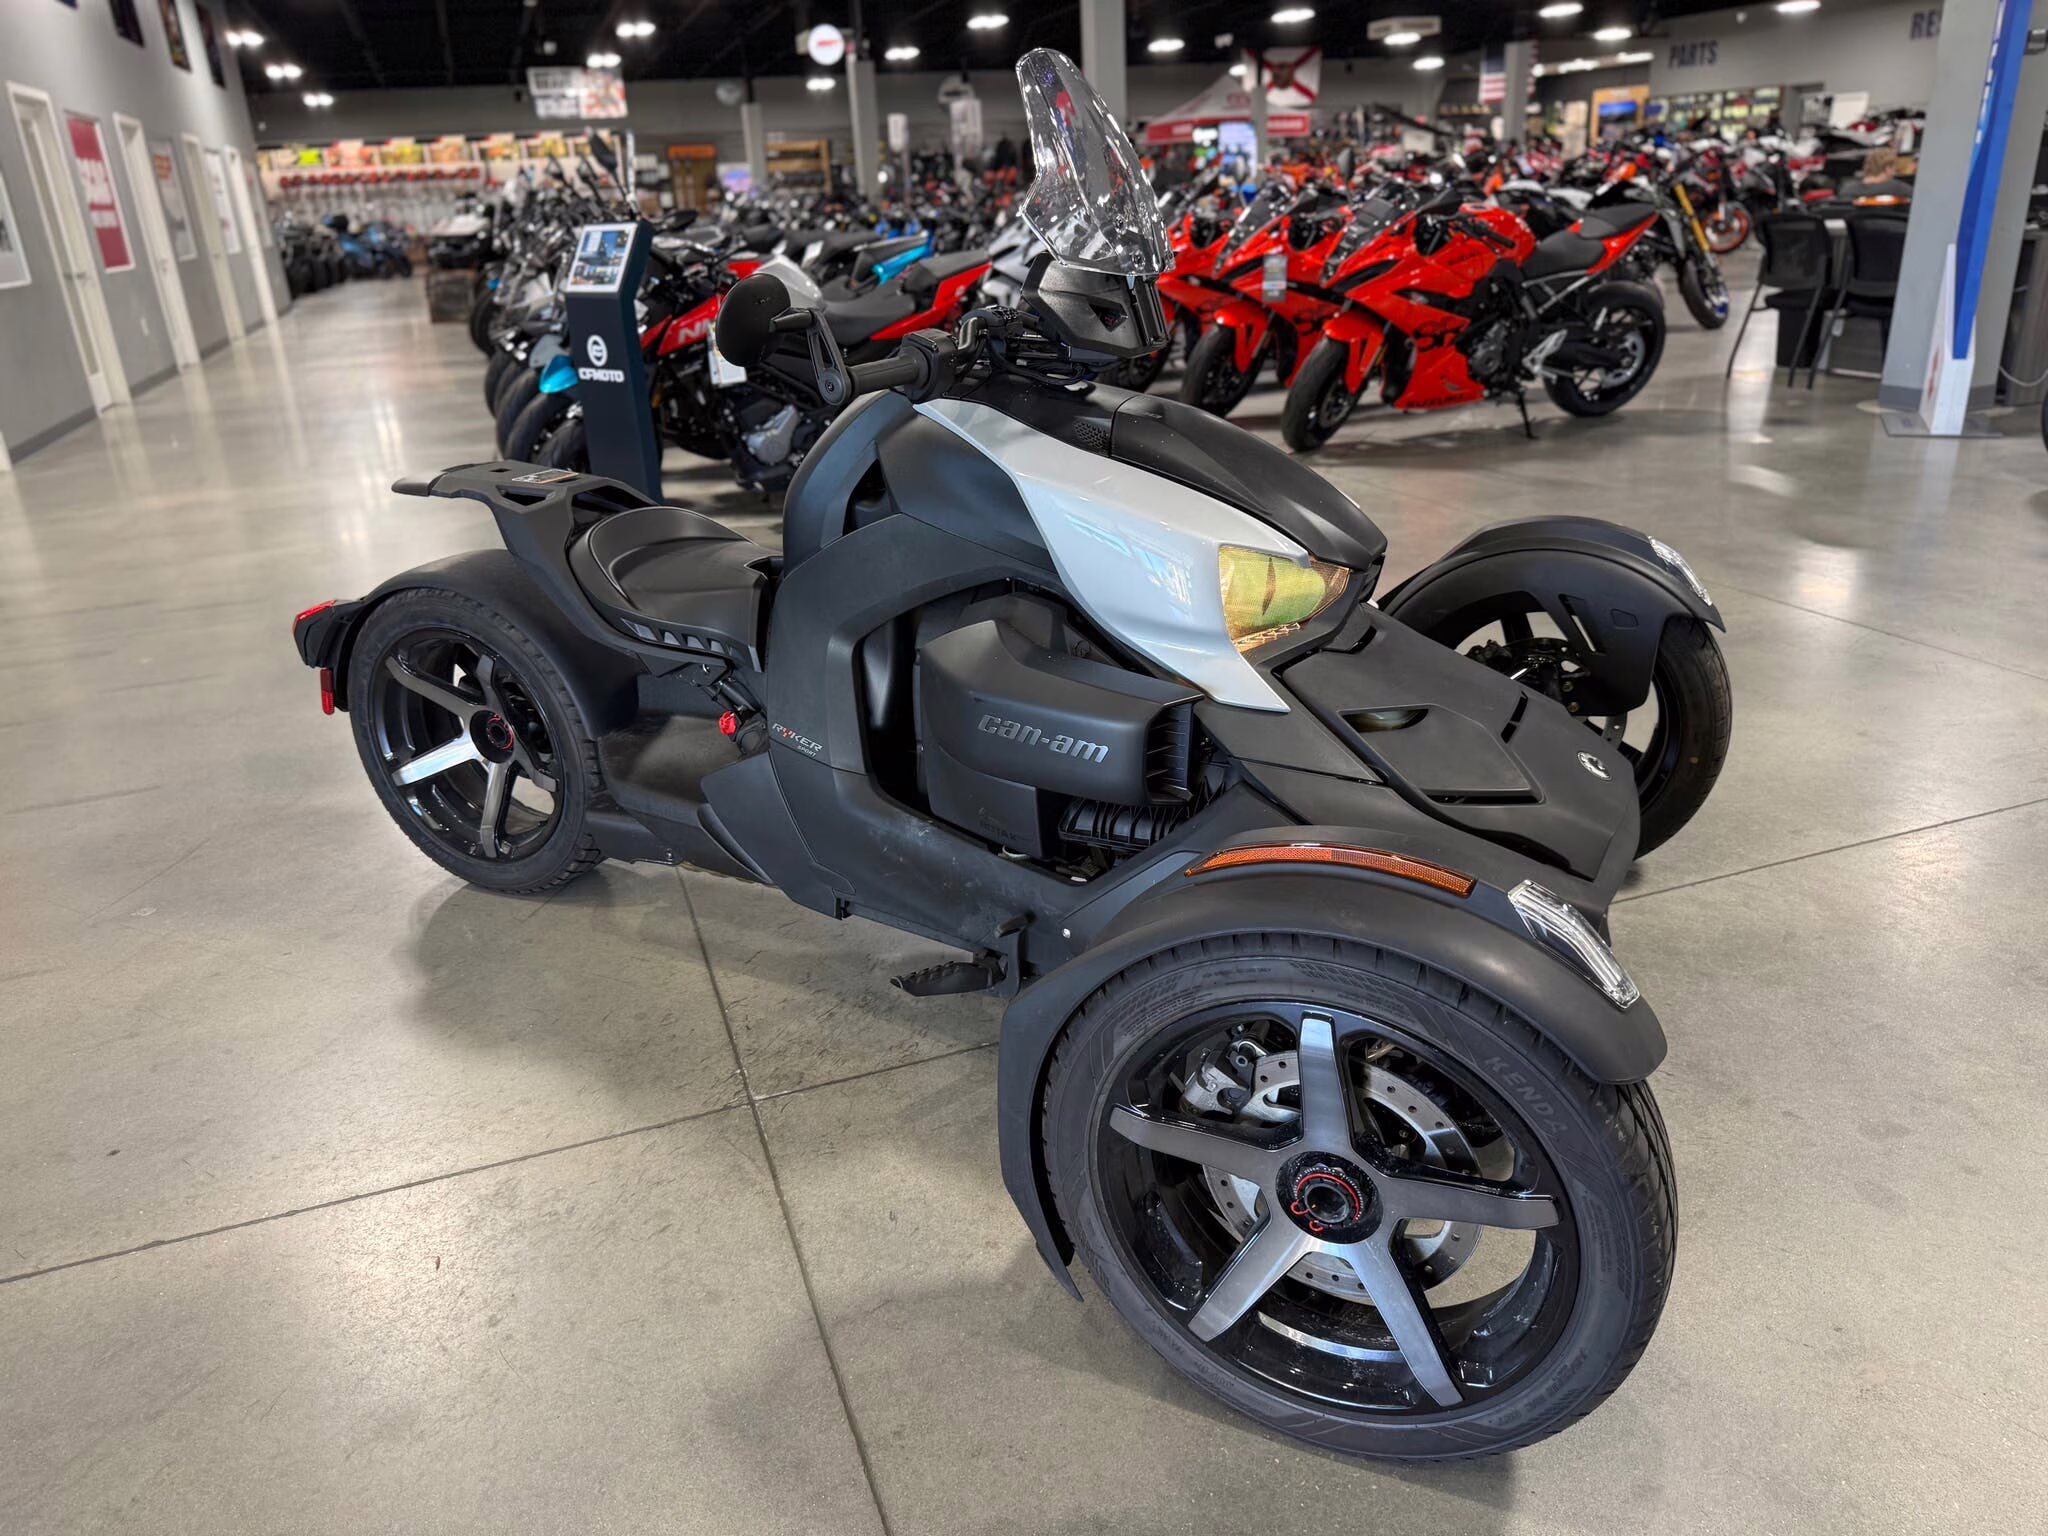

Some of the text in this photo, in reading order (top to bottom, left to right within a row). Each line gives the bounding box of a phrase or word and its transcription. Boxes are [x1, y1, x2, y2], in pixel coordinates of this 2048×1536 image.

[1669, 40, 1719, 69] PARTS
[577, 367, 625, 383] CFMOTO
[771, 722, 823, 752] RYKER
[797, 744, 817, 757] SPORT
[976, 714, 1110, 764] can-am
[1484, 1055, 1568, 1133] KENDA
